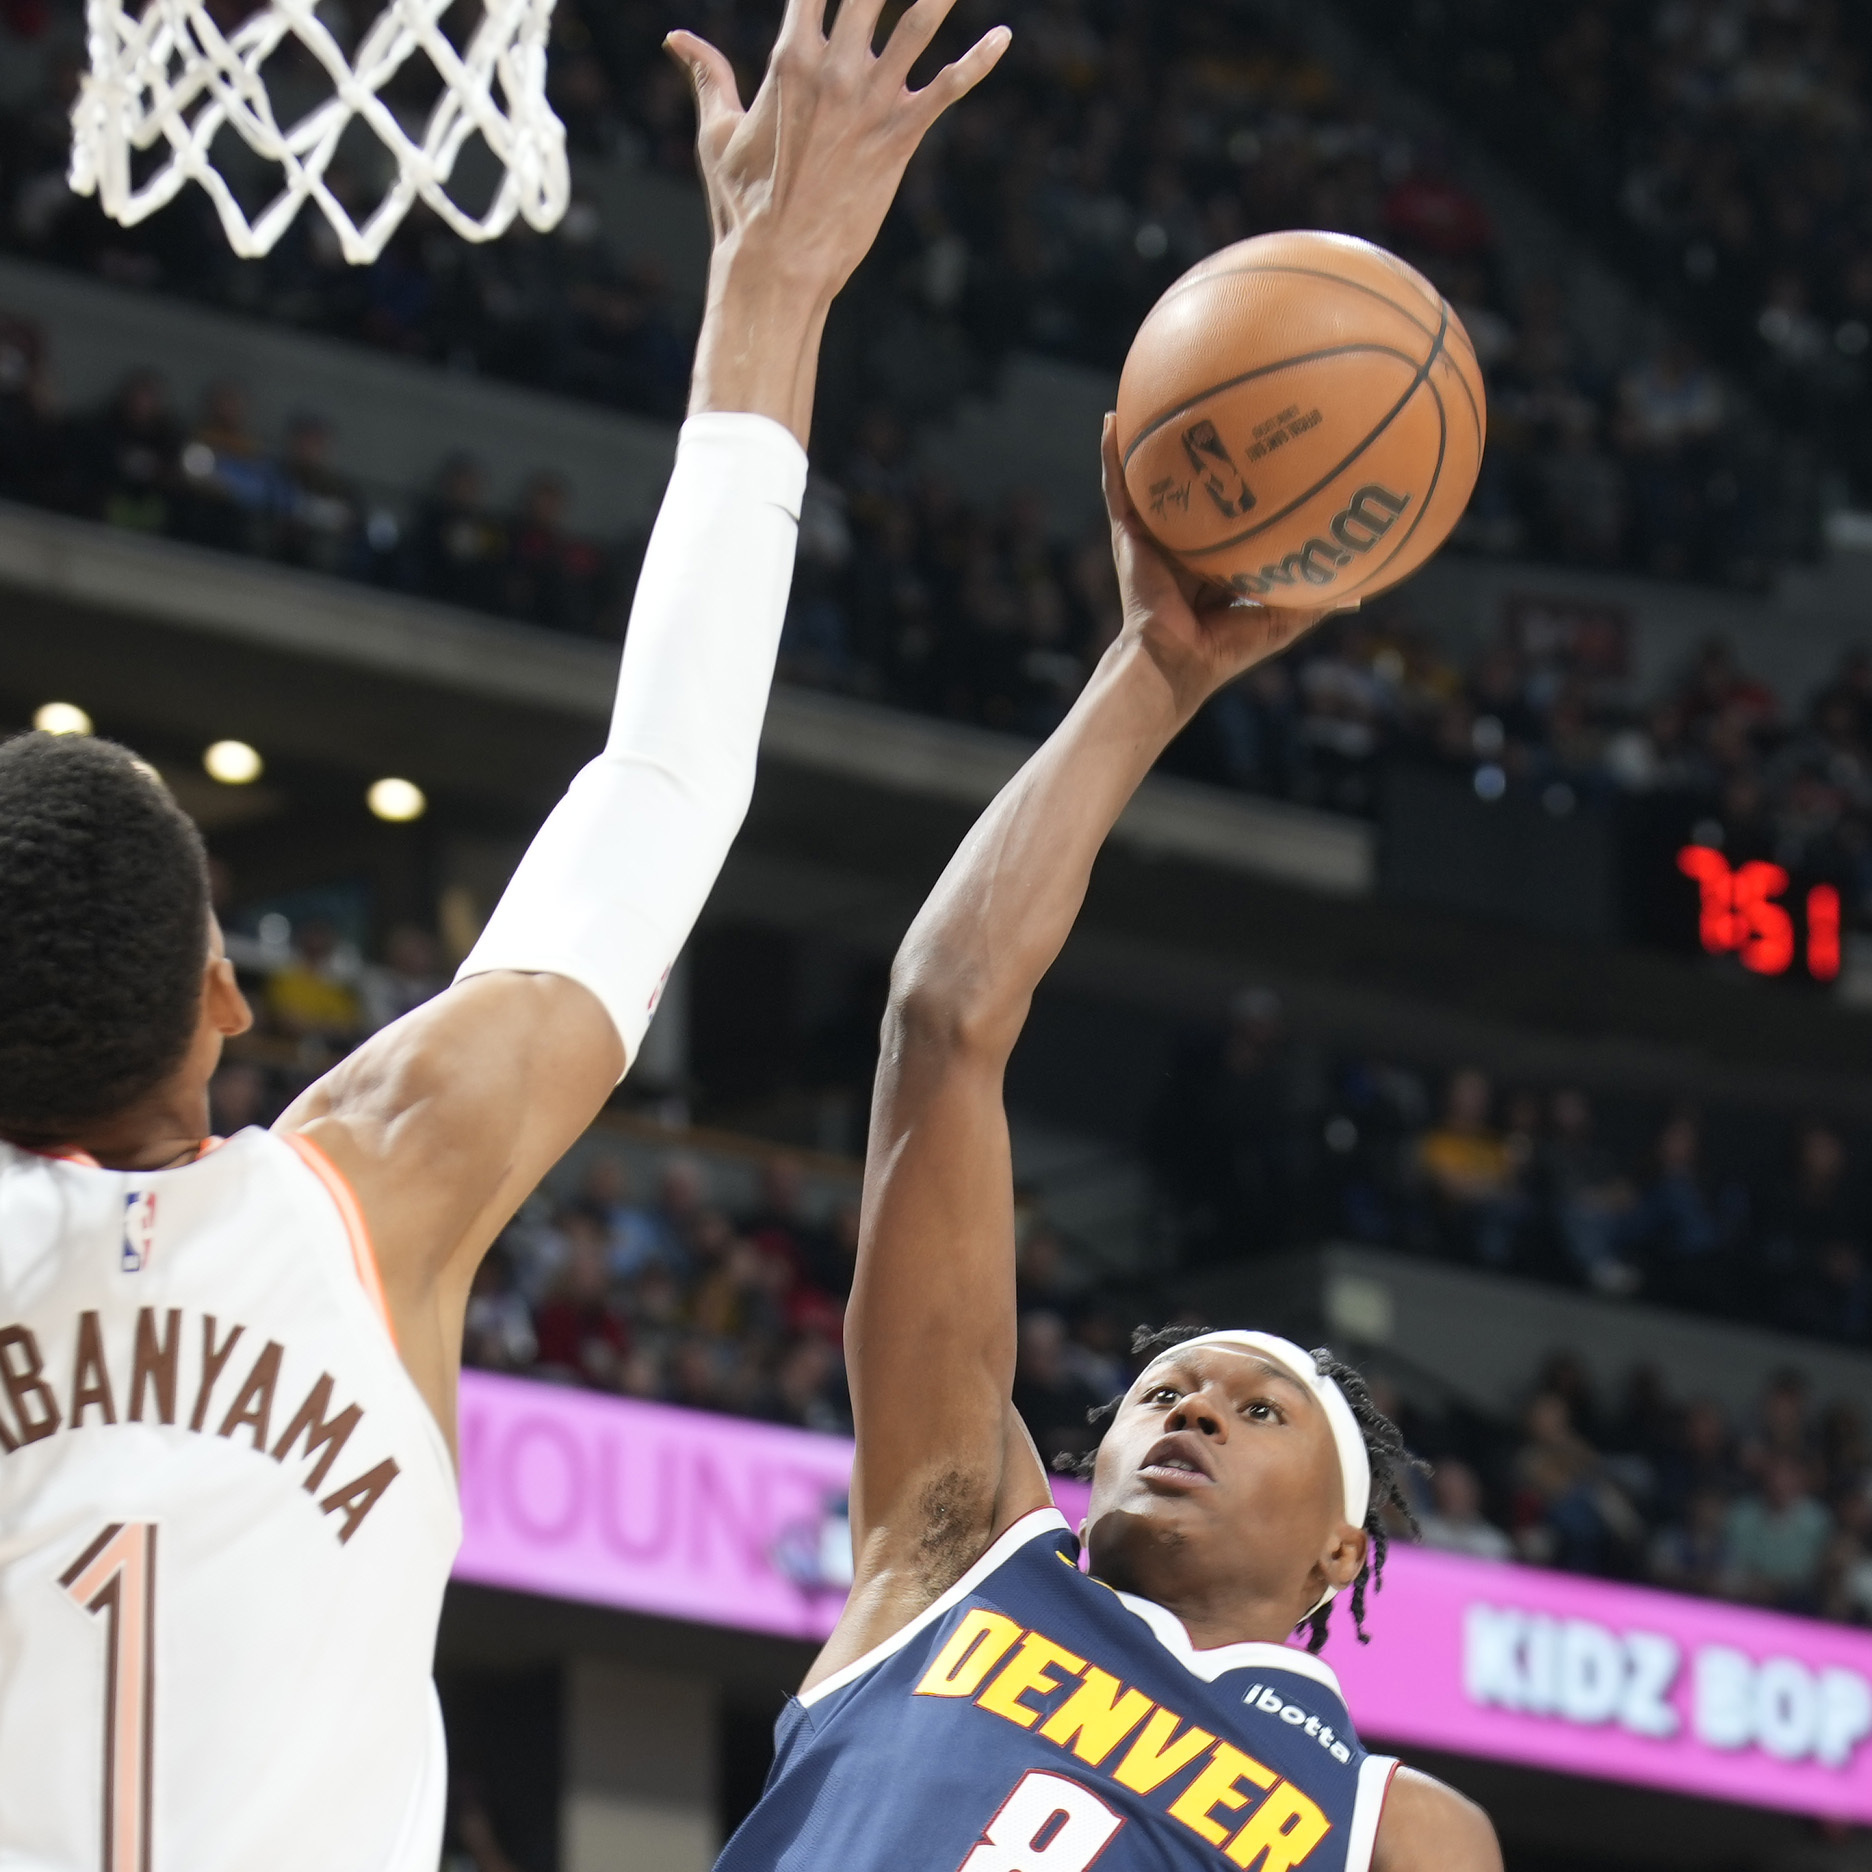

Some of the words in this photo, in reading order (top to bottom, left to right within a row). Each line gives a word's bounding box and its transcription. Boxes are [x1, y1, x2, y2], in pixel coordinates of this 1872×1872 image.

[1229, 484, 1412, 596] Wilso
[1243, 1682, 1352, 1765] ibotta
[1462, 1603, 1680, 1739] KIDZ
